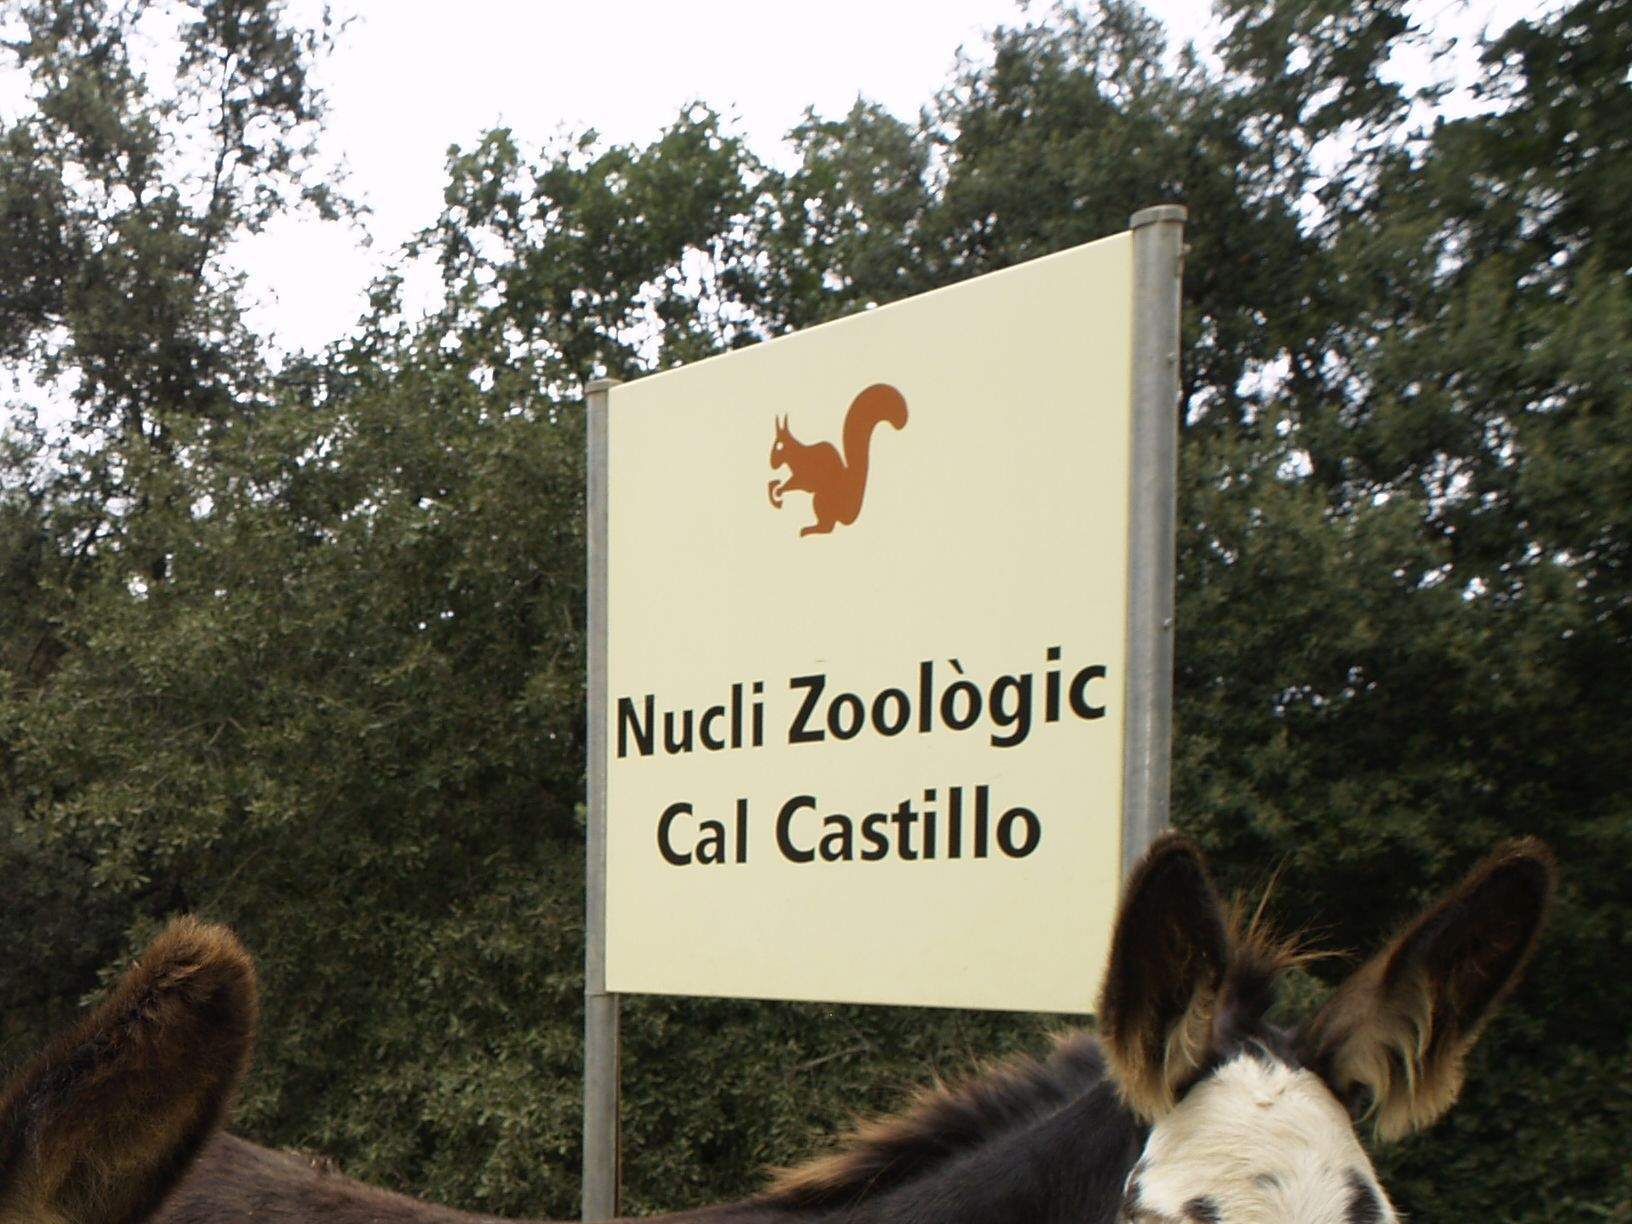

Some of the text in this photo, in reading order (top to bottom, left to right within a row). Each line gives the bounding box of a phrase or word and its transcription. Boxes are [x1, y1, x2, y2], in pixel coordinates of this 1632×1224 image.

[617, 646, 1107, 759] Nucli Zoològic
[657, 784, 1041, 867] Cal Castillo
